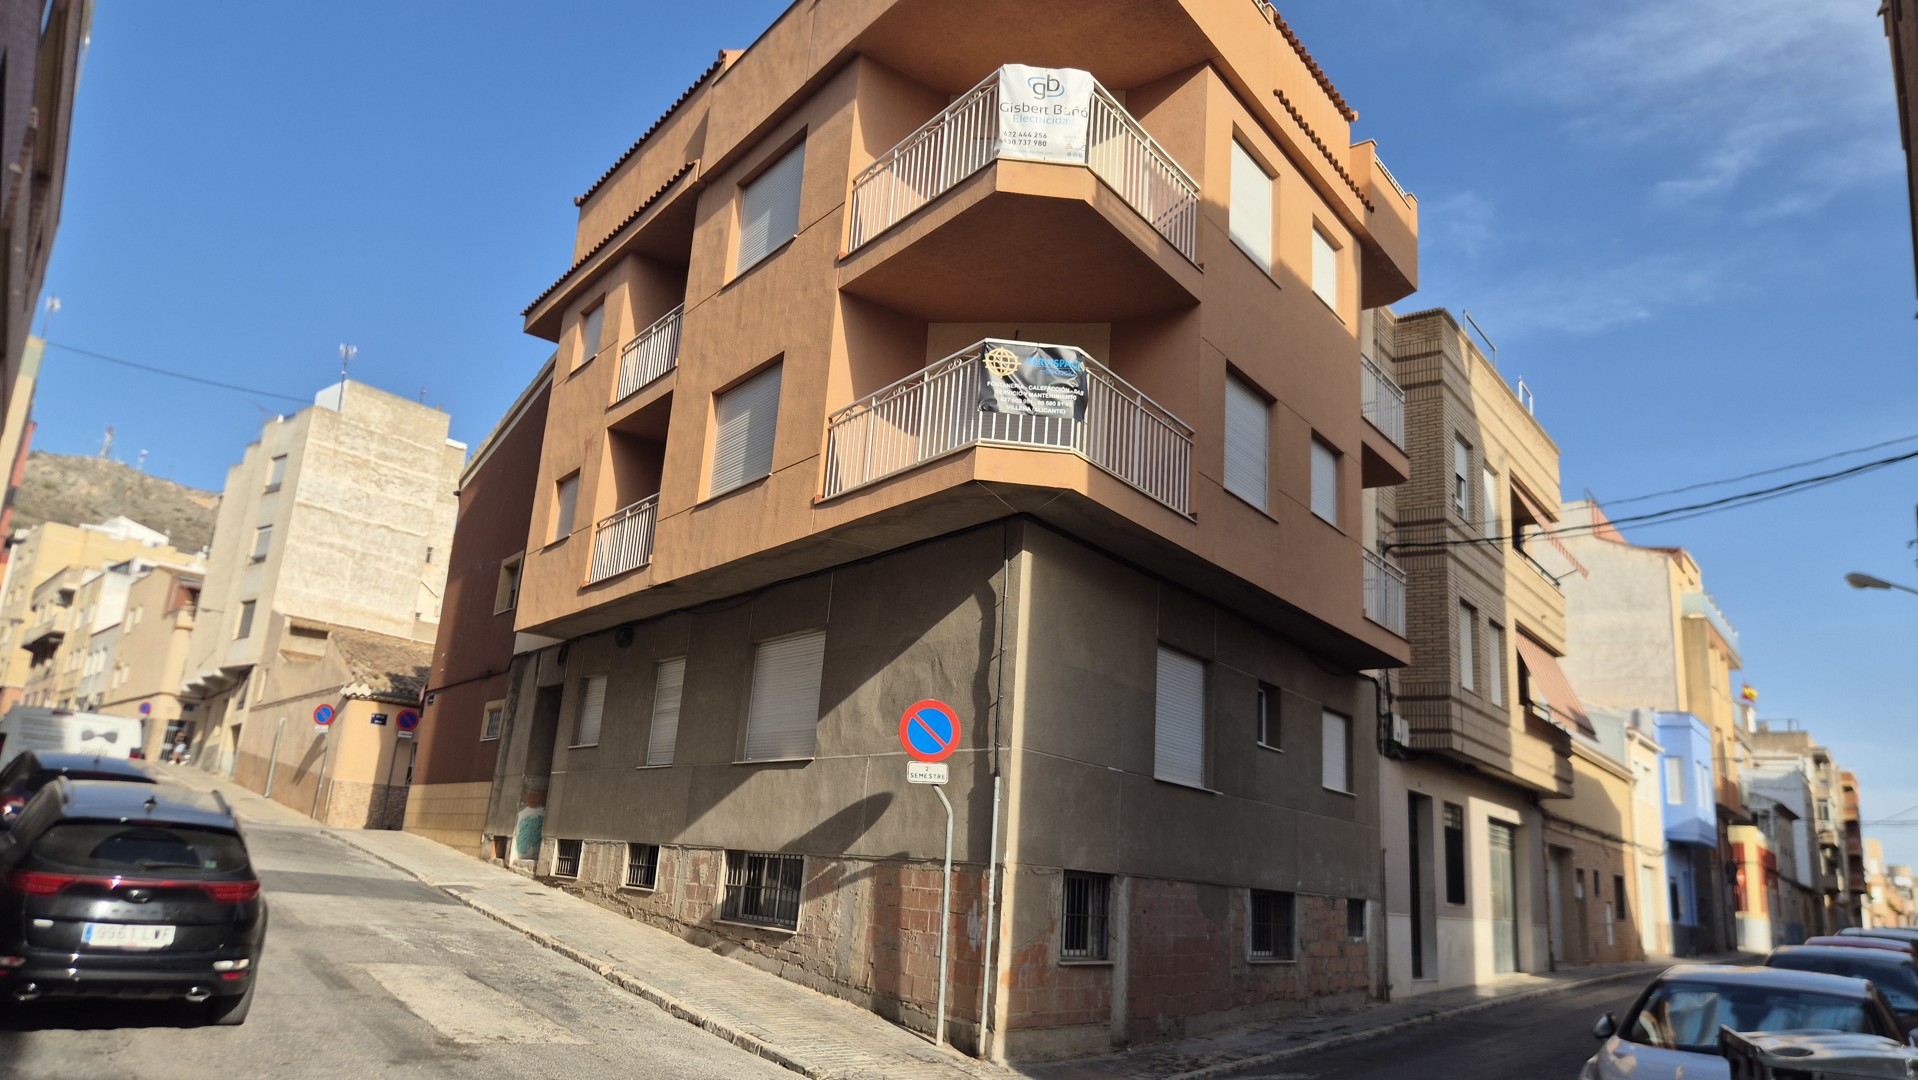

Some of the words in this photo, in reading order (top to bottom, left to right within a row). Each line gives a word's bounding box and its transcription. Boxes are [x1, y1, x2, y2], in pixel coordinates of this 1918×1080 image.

[1000, 102, 1049, 115] Gisbert
[1013, 114, 1076, 125] Electricidad
[910, 772, 946, 780] SEMESTRE
